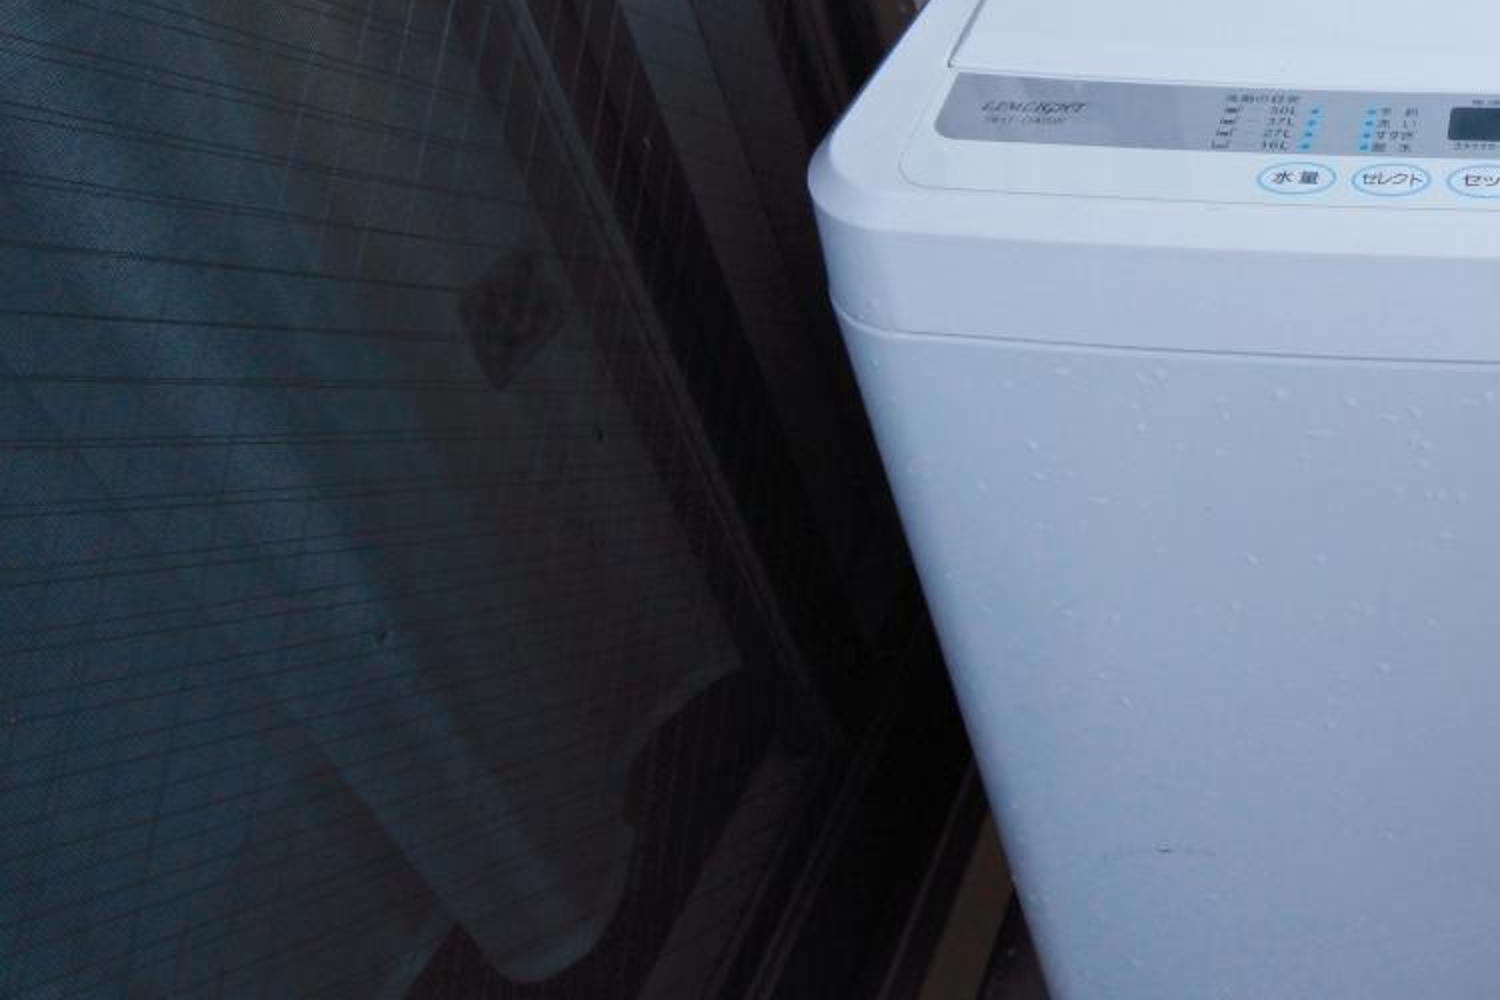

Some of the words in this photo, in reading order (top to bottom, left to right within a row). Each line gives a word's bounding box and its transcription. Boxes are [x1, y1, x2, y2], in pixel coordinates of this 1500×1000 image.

[1272, 170, 1320, 185] 水量
[1362, 172, 1424, 186] セレクト
